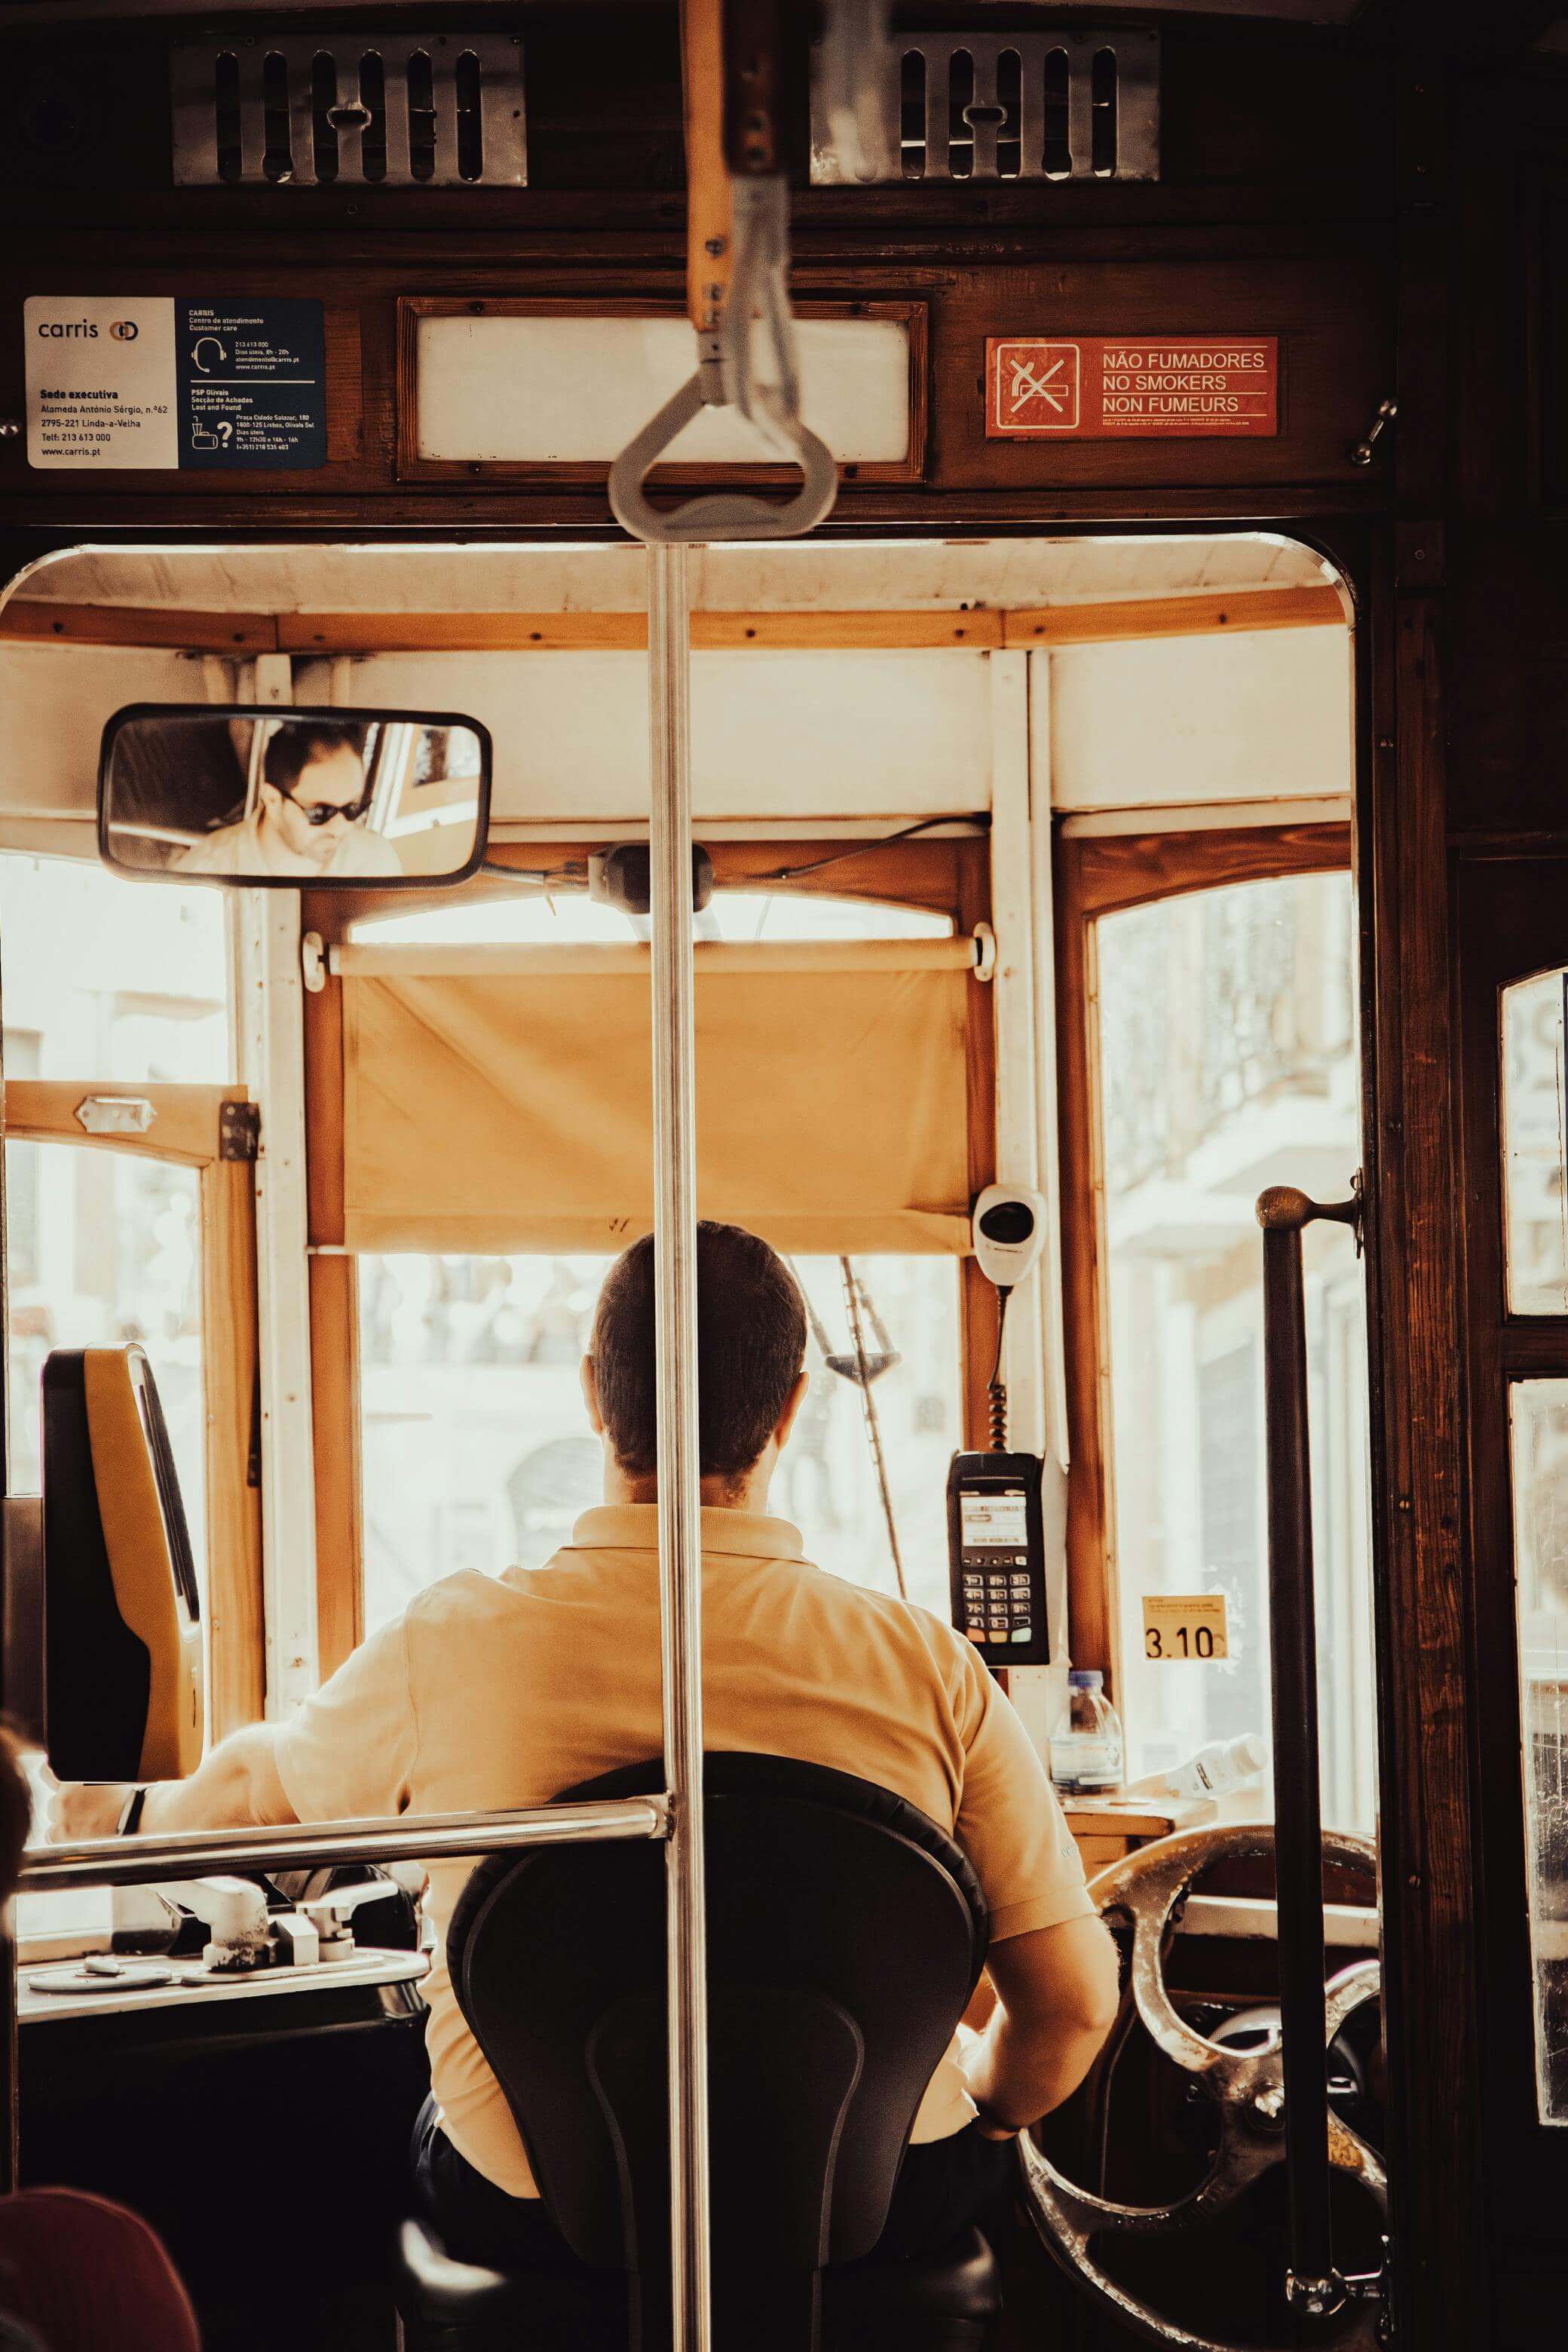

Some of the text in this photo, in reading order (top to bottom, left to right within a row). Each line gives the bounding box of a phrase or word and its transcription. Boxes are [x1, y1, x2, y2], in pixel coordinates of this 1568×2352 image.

[38, 318, 98, 338] carris
[1104, 351, 1265, 369] NÃO FUMADORES
[1103, 375, 1227, 390] NO SMOKERS
[40, 390, 118, 400] Sede executiva
[113, 406, 143, 415] Sérgio,
[1102, 397, 1239, 413] NON FUMEURS
[41, 419, 141, 427] 2795-221 Linda-a-Velha
[62, 433, 76, 442] 213
[78, 433, 93, 442] 613
[96, 433, 111, 442] 000
[42, 448, 101, 457] www.carris.pt
[1146, 1627, 1214, 1658] 3.10
